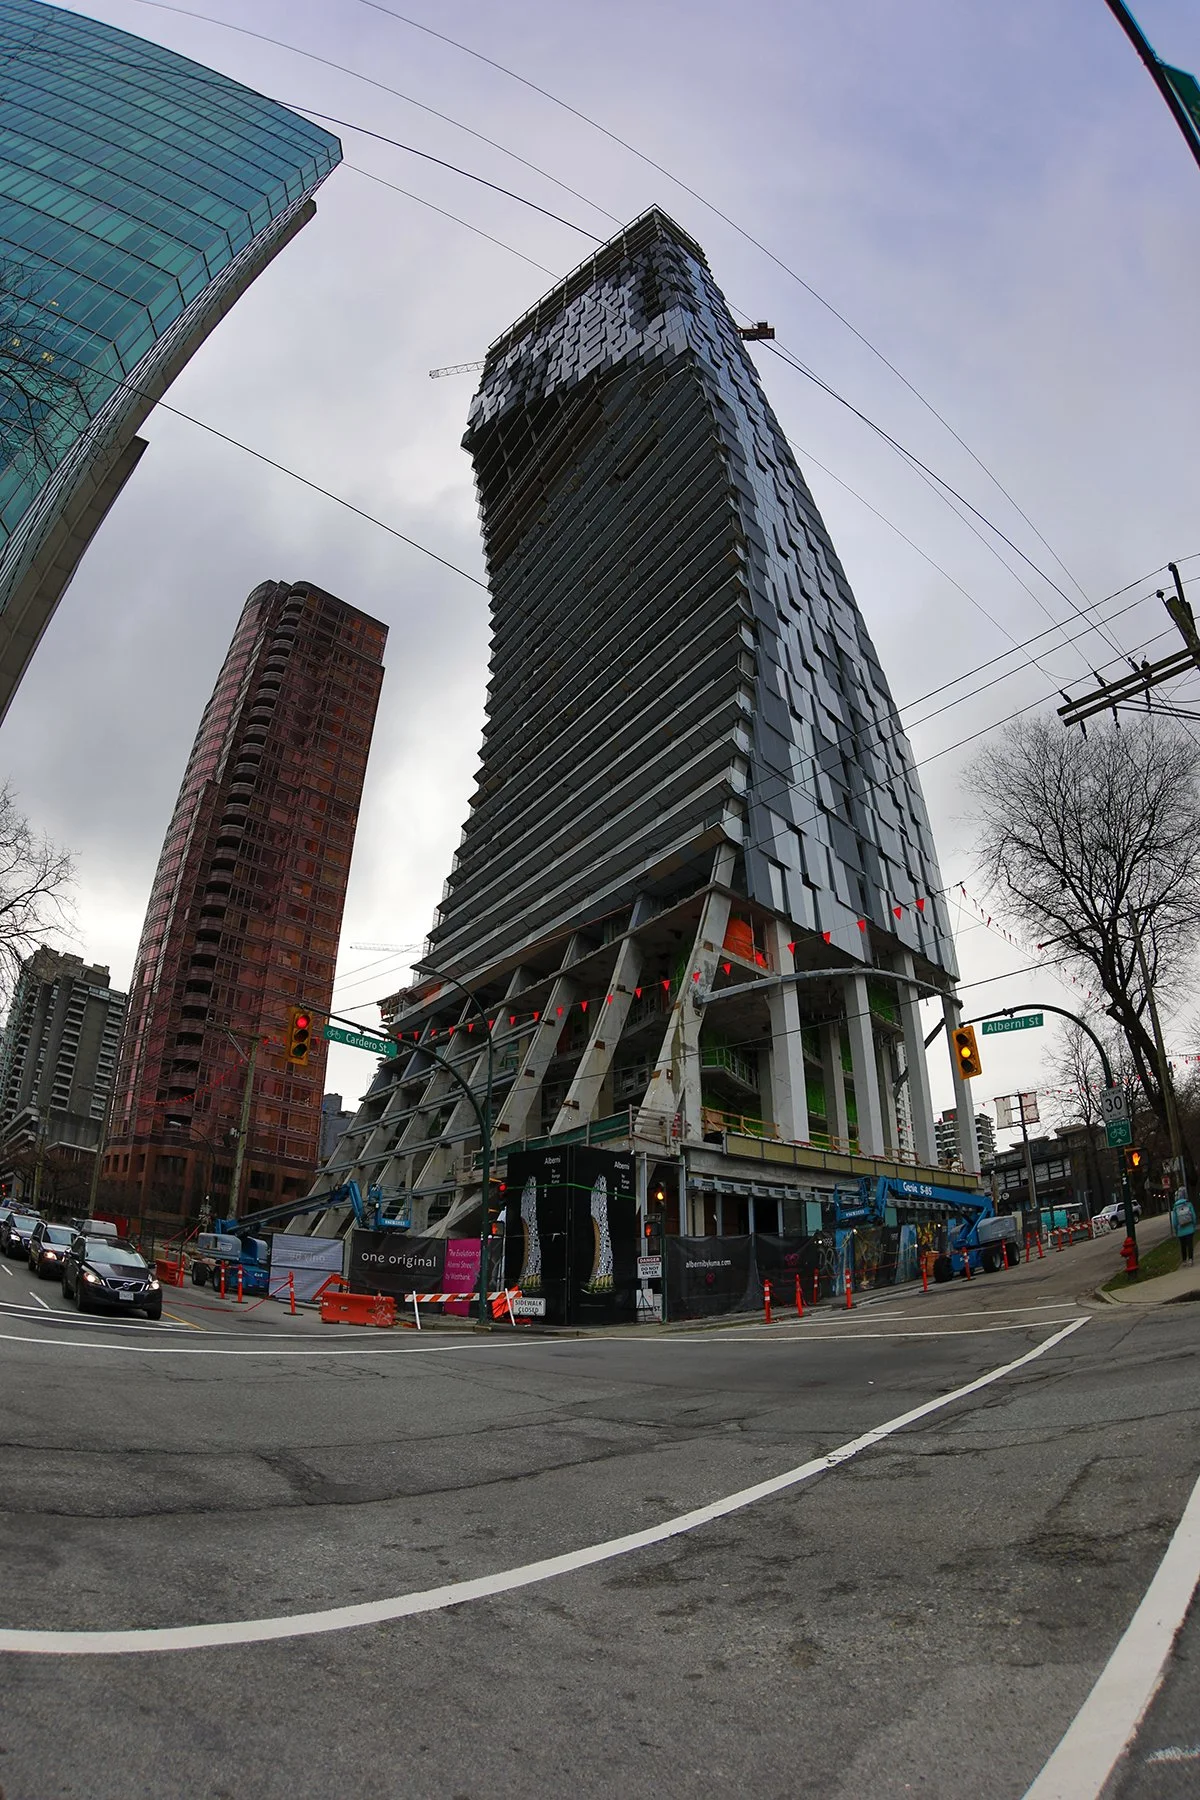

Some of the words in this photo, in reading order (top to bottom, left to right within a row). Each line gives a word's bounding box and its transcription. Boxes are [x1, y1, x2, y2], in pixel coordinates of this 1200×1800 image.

[986, 1017, 1025, 1033] Alberni
[1028, 1016, 1039, 1027] St
[345, 1032, 378, 1050] Cardero
[378, 1042, 390, 1054] St.
[1105, 1096, 1122, 1112] 30
[903, 1181, 918, 1193] Genie
[920, 1185, 932, 1196] S-85
[361, 1252, 385, 1263] one
[389, 1254, 437, 1268] original
